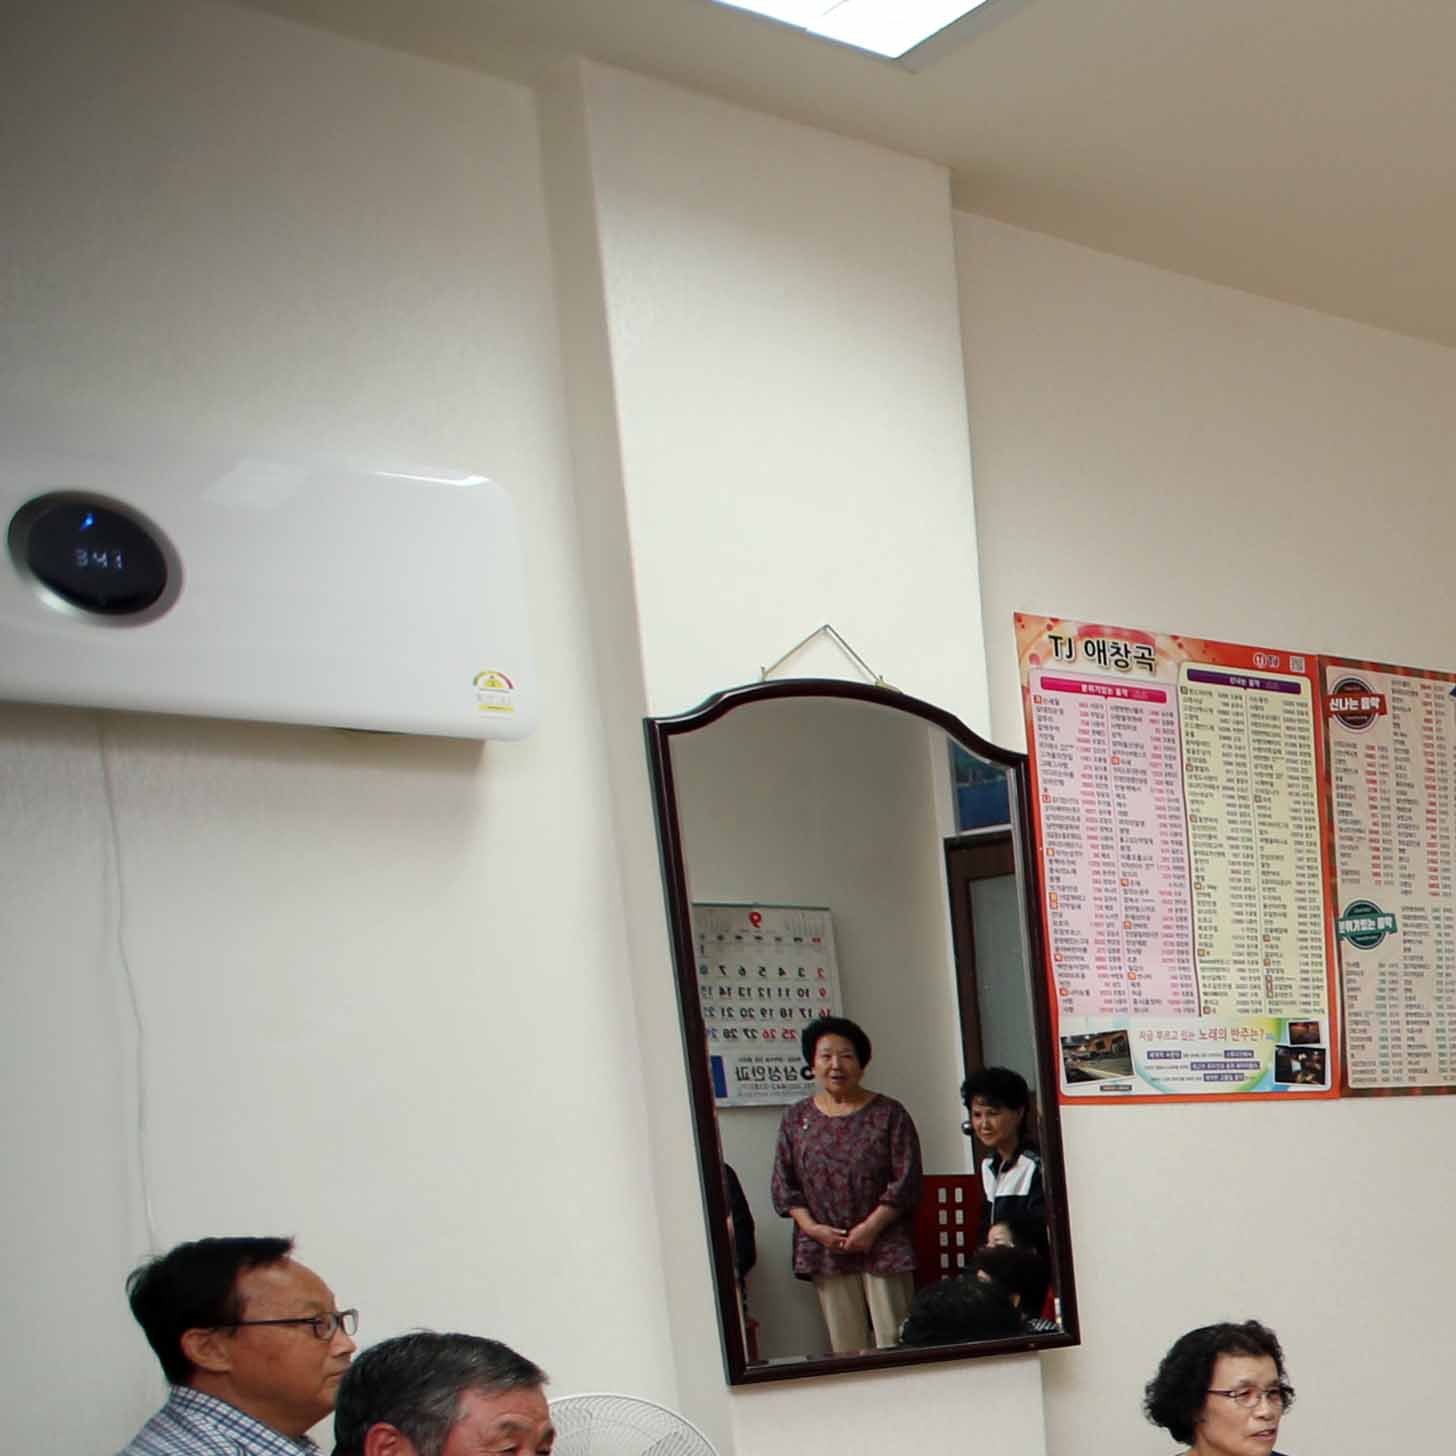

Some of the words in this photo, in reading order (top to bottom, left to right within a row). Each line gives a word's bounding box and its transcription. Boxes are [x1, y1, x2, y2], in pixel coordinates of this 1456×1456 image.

[1048, 635, 1074, 660] TJ
[1083, 638, 1157, 673] 애창곡
[1329, 696, 1359, 711] 신나는
[1198, 1028, 1228, 1042] 노래의
[1230, 1028, 1265, 1042] 반주는?
